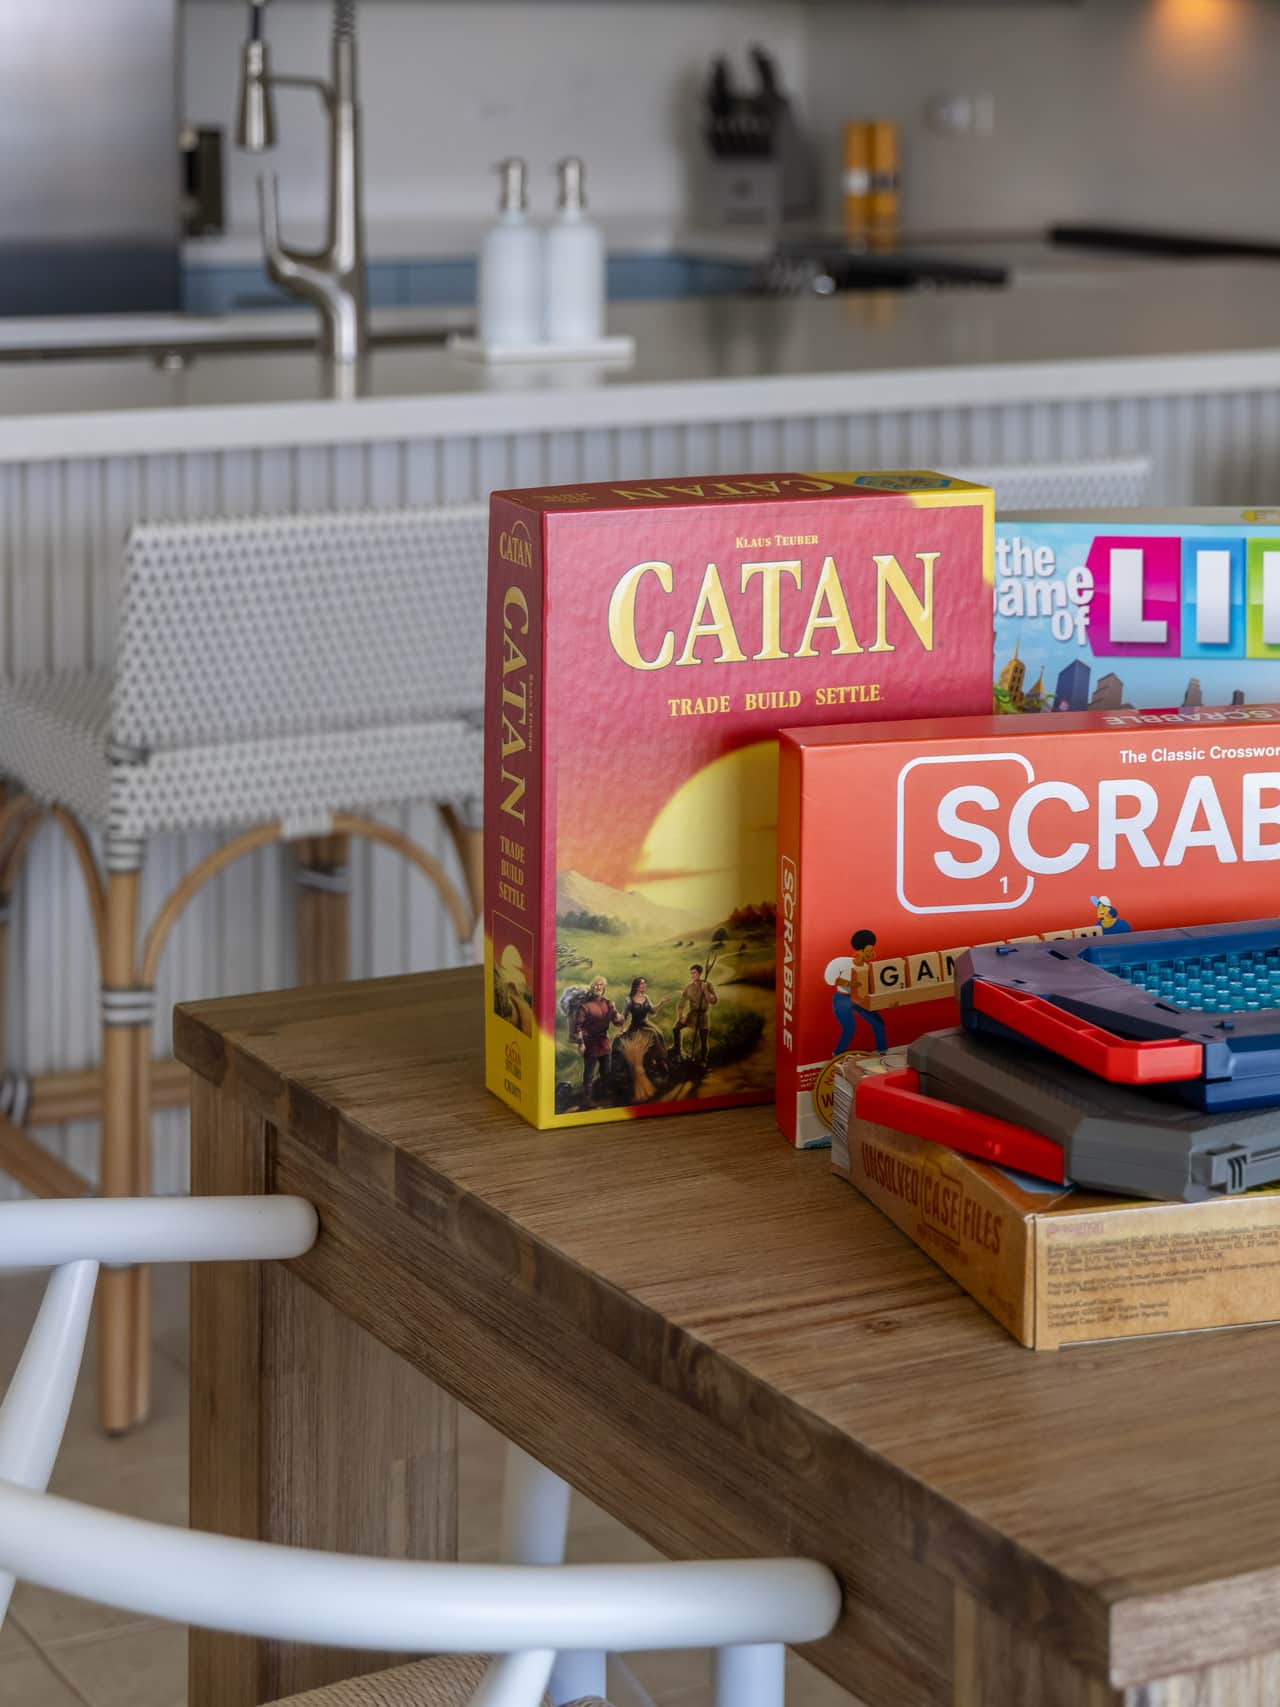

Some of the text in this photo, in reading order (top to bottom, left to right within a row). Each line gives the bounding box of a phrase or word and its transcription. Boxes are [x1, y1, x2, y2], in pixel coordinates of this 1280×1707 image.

[610, 478, 836, 500] CATAN
[500, 531, 532, 568] CATAN
[735, 533, 820, 549] KLAUS TEUBER
[995, 536, 1056, 577] the
[993, 566, 1095, 618] ame
[608, 551, 942, 671] CATAN
[1052, 605, 1091, 645] of
[500, 586, 529, 827] CATAN
[668, 684, 881, 717] TRADE BUILD SETTLE
[1119, 748, 1148, 764] The
[1151, 746, 1206, 763] Classic
[500, 835, 525, 864] TRADE
[498, 881, 526, 911] SETTLE
[999, 876, 1009, 894] 1
[781, 868, 796, 1053] SCRABBLE
[861, 1141, 919, 1207] UNSOLVED
[924, 1175, 959, 1231] CASE
[962, 1197, 1002, 1255] FILES
